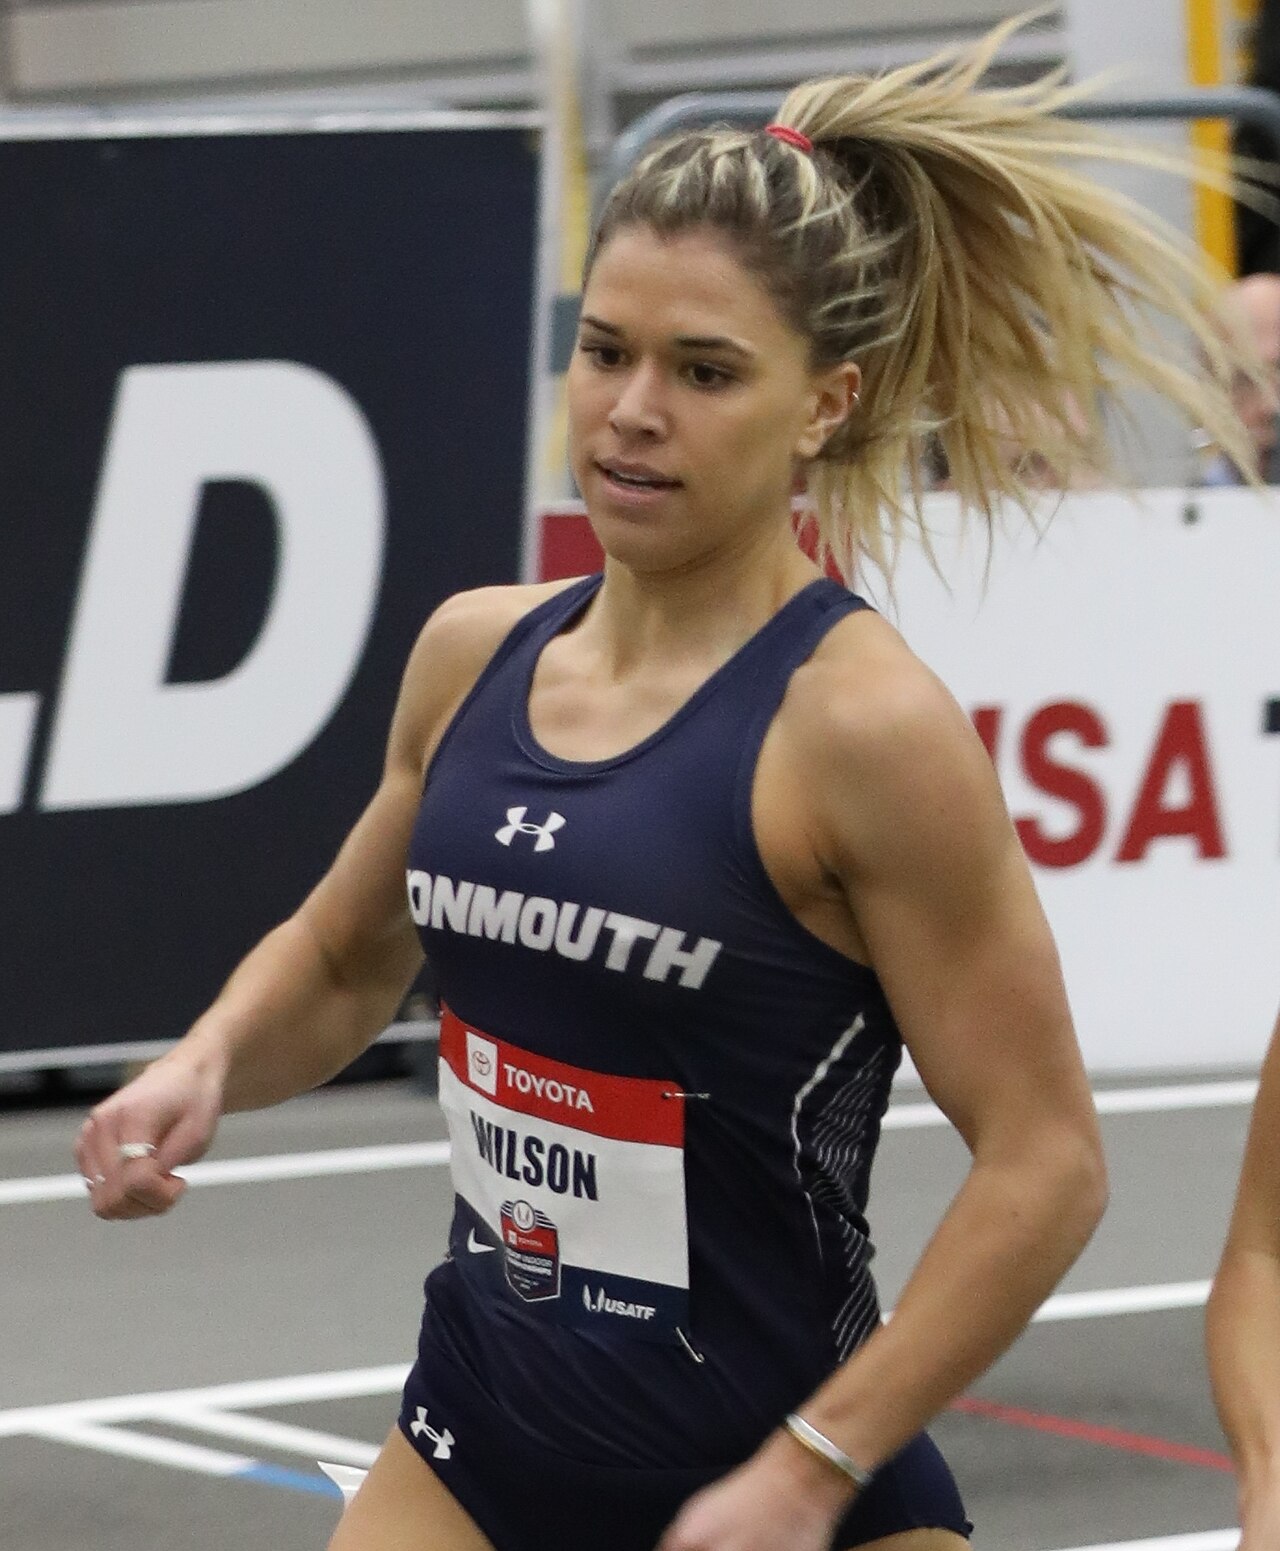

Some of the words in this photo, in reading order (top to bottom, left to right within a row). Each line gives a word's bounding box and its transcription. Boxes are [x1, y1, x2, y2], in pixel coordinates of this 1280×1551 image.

[406, 868, 723, 990] ONMOUTH
[503, 1063, 595, 1114] TOYOTA
[470, 1109, 599, 1202] WILSON
[604, 1298, 656, 1321] USATF
